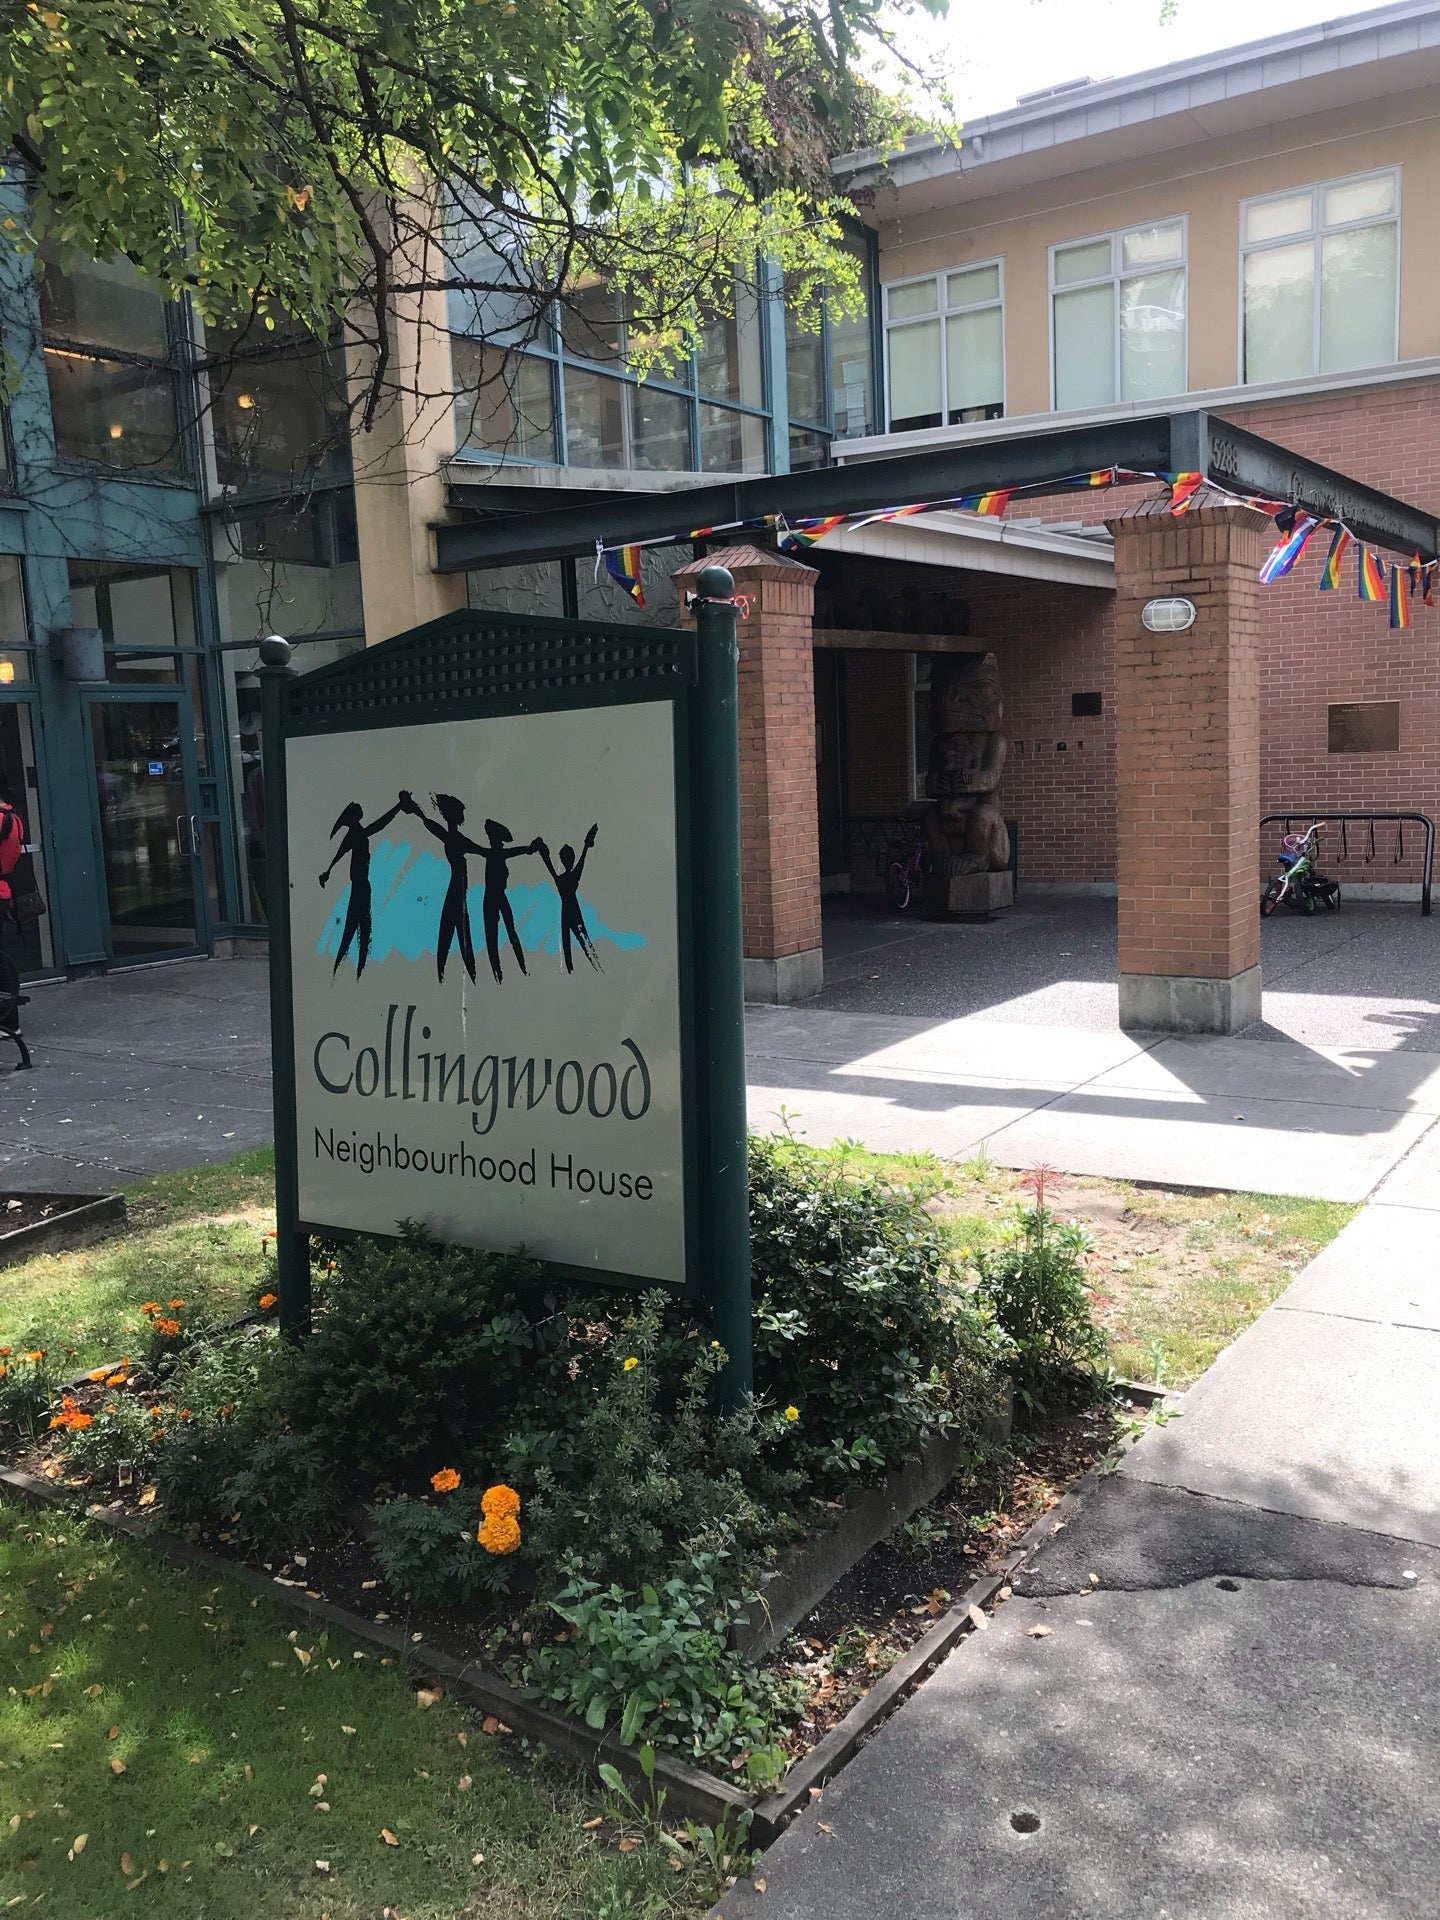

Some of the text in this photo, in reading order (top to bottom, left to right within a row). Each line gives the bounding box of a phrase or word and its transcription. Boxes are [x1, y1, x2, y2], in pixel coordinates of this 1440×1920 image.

[1211, 438, 1239, 476] 5288
[313, 1004, 651, 1135] Collingwood
[314, 1126, 653, 1200] Neighbourhood House
